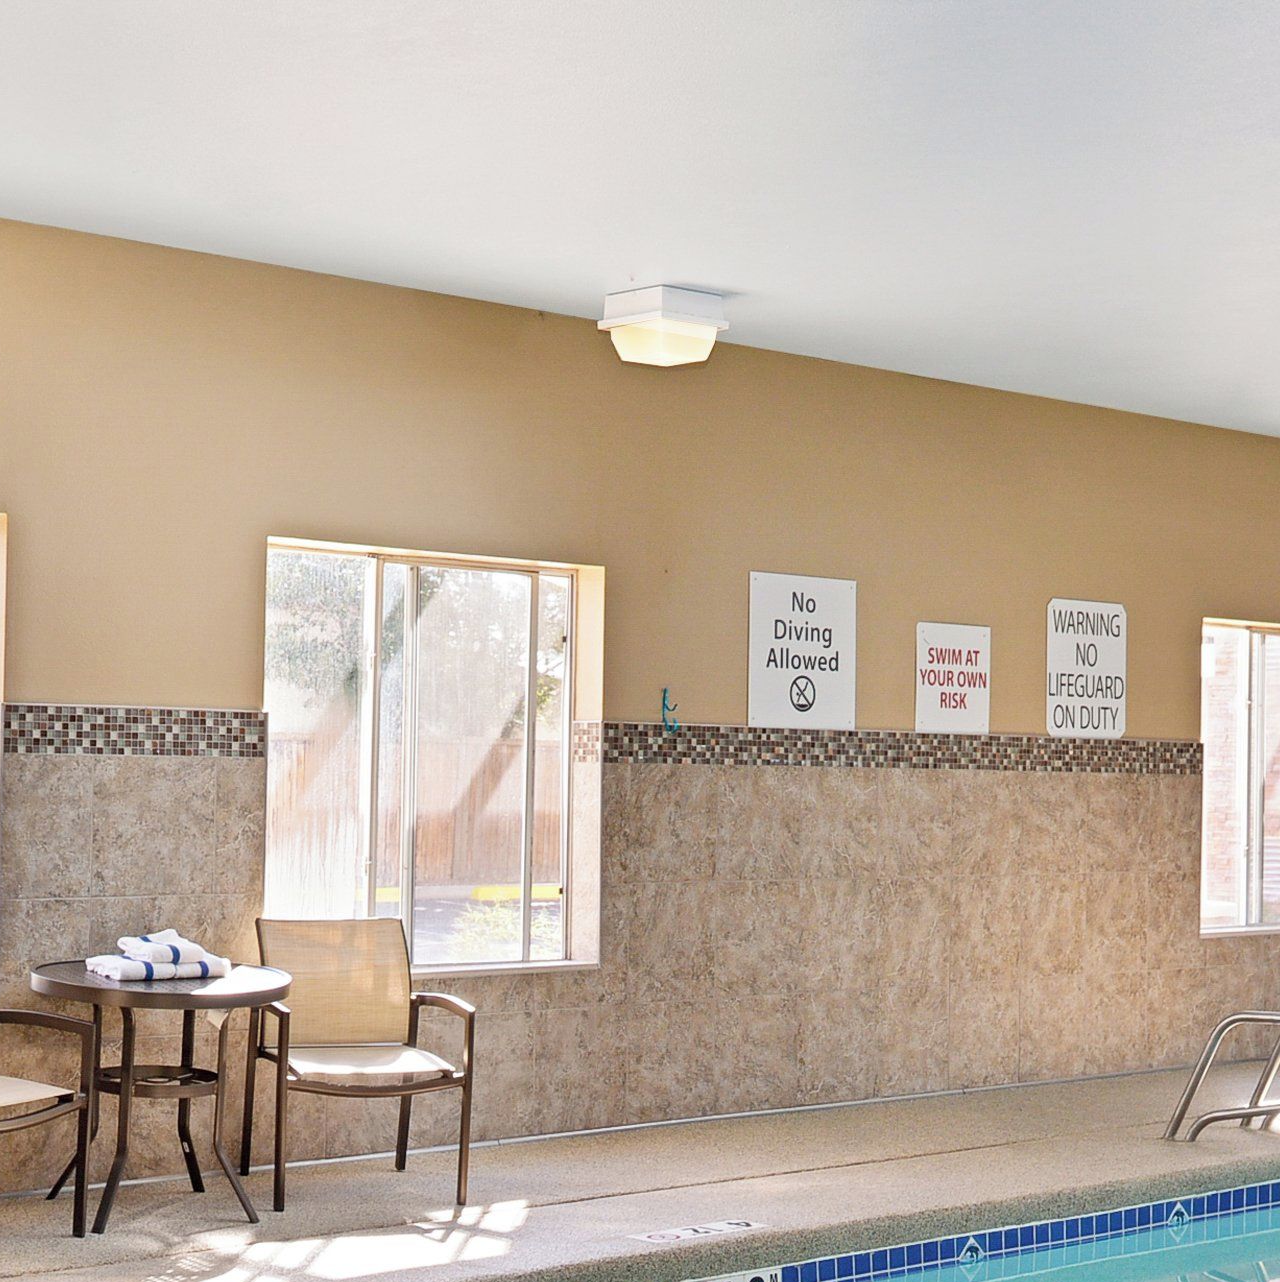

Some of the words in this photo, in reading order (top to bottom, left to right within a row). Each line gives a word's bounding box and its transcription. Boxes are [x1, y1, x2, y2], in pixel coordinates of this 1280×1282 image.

[792, 591, 817, 613] No
[774, 619, 832, 648] Diving
[1053, 609, 1120, 637] WARNING
[766, 647, 839, 672] Allowed
[927, 647, 962, 666] SWIM
[965, 649, 980, 667] AT
[1076, 642, 1098, 667] NO
[919, 668, 954, 687] YOUR
[957, 671, 987, 689] OWN
[1048, 672, 1124, 699] LIFEGUARD
[940, 692, 967, 709] RISK
[1053, 704, 1075, 729] ON
[1080, 705, 1119, 730] DUTY
